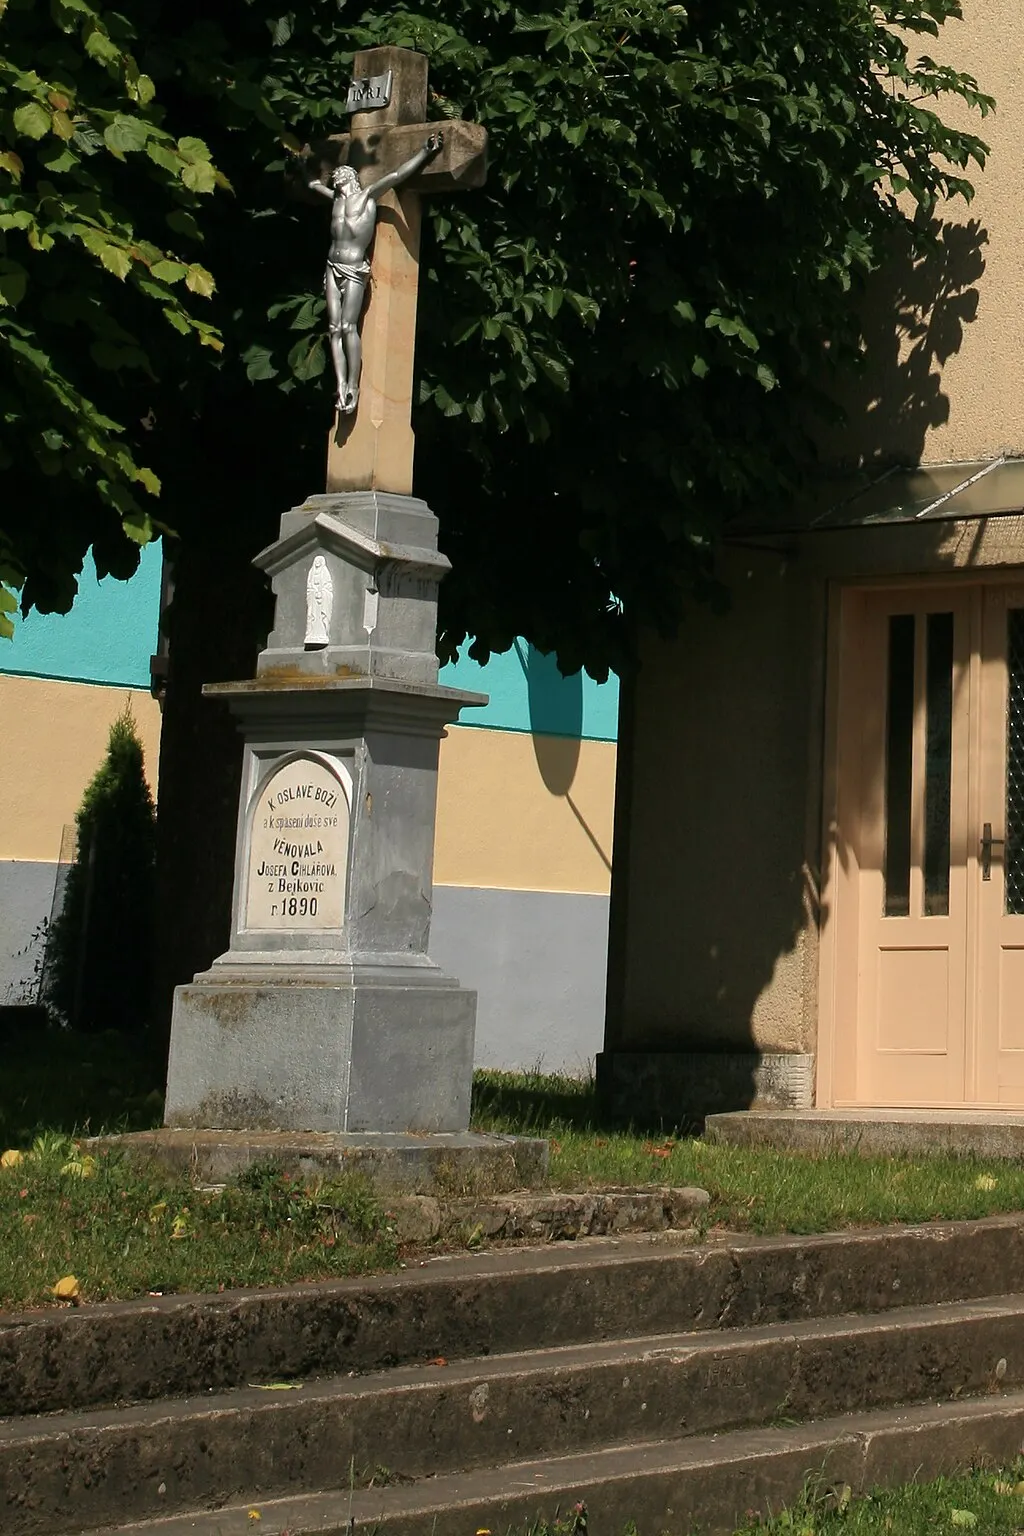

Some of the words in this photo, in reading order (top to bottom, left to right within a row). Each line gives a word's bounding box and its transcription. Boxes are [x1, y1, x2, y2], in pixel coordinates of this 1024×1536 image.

[352, 86, 381, 102] INRI
[268, 798, 276, 812] K
[315, 787, 339, 809] BOŽÍ
[263, 818, 268, 828] a
[269, 815, 275, 828] k
[273, 837, 323, 858] VĚNOVALA
[257, 861, 287, 876] JOSEFA
[268, 882, 274, 892] z
